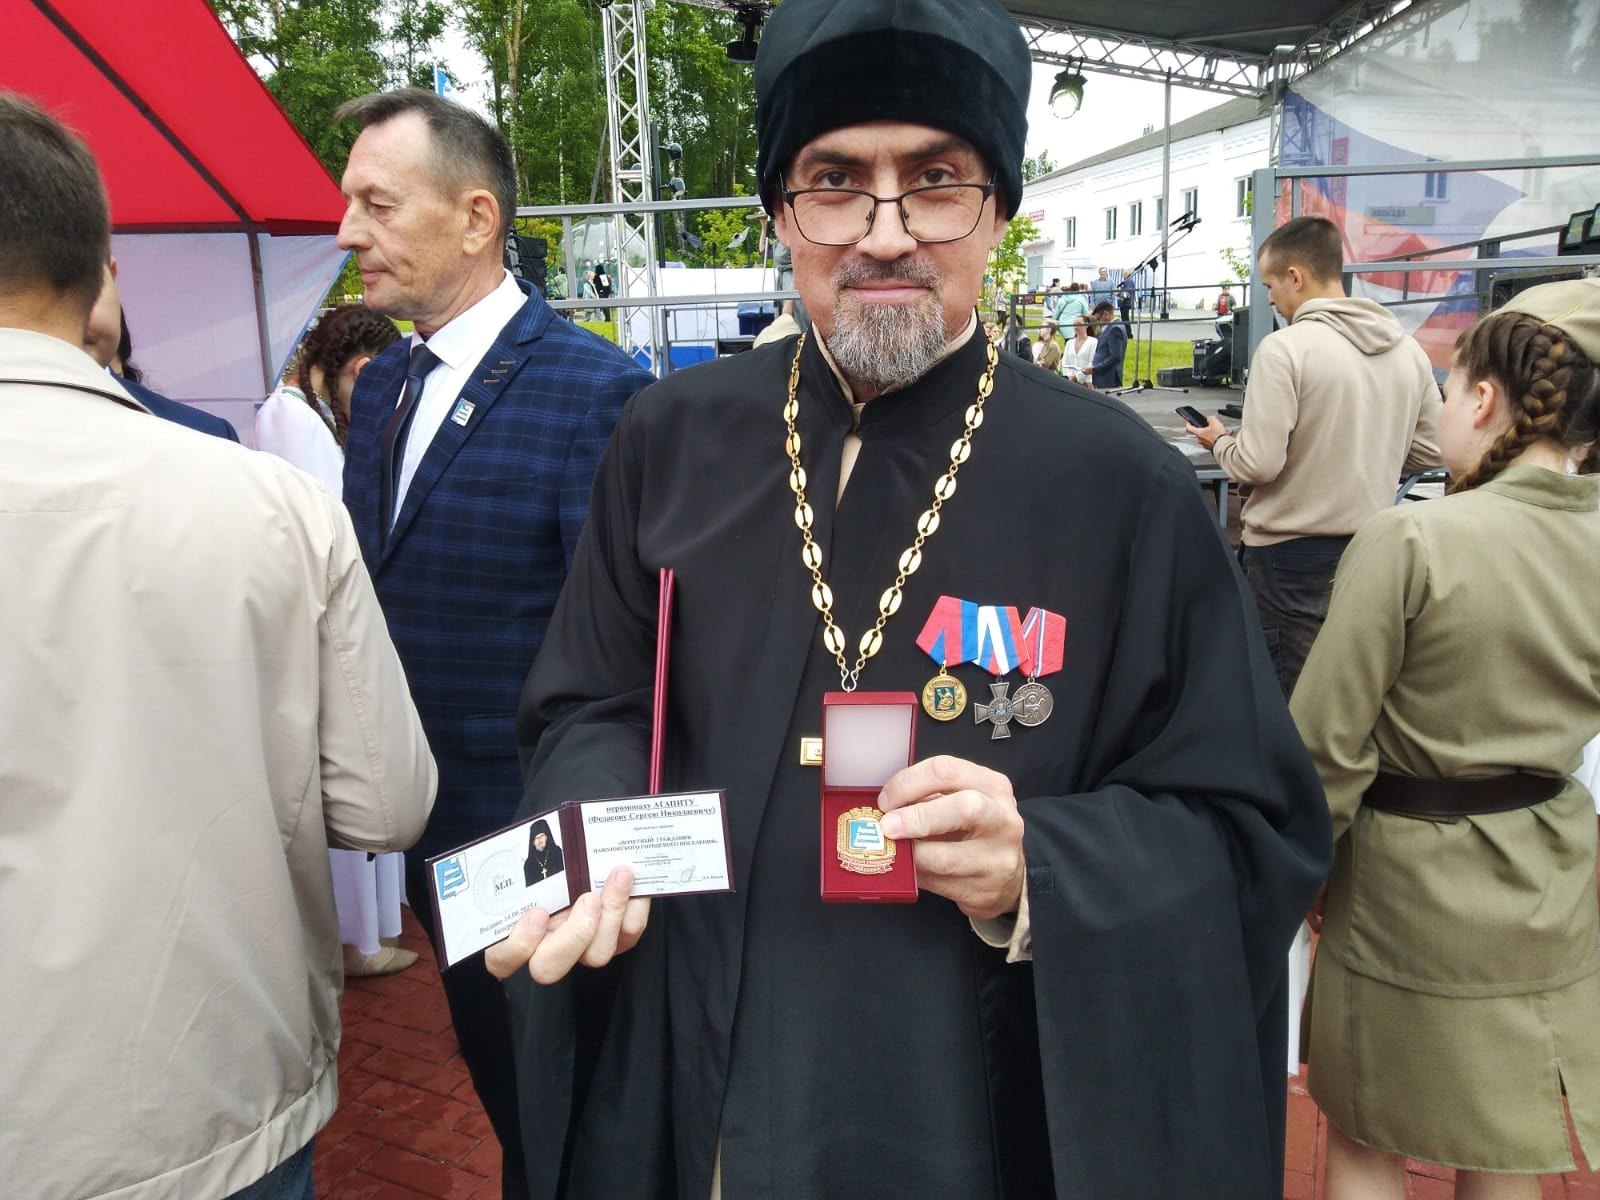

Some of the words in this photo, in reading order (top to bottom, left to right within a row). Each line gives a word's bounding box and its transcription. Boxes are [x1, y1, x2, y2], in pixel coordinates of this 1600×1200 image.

[654, 799, 696, 809] АГАПИТУ
[629, 812, 659, 821] Сергею
[660, 806, 716, 818] Николаевичу)
[495, 878, 515, 893] М.П.
[504, 902, 533, 921] 14.06.2025
